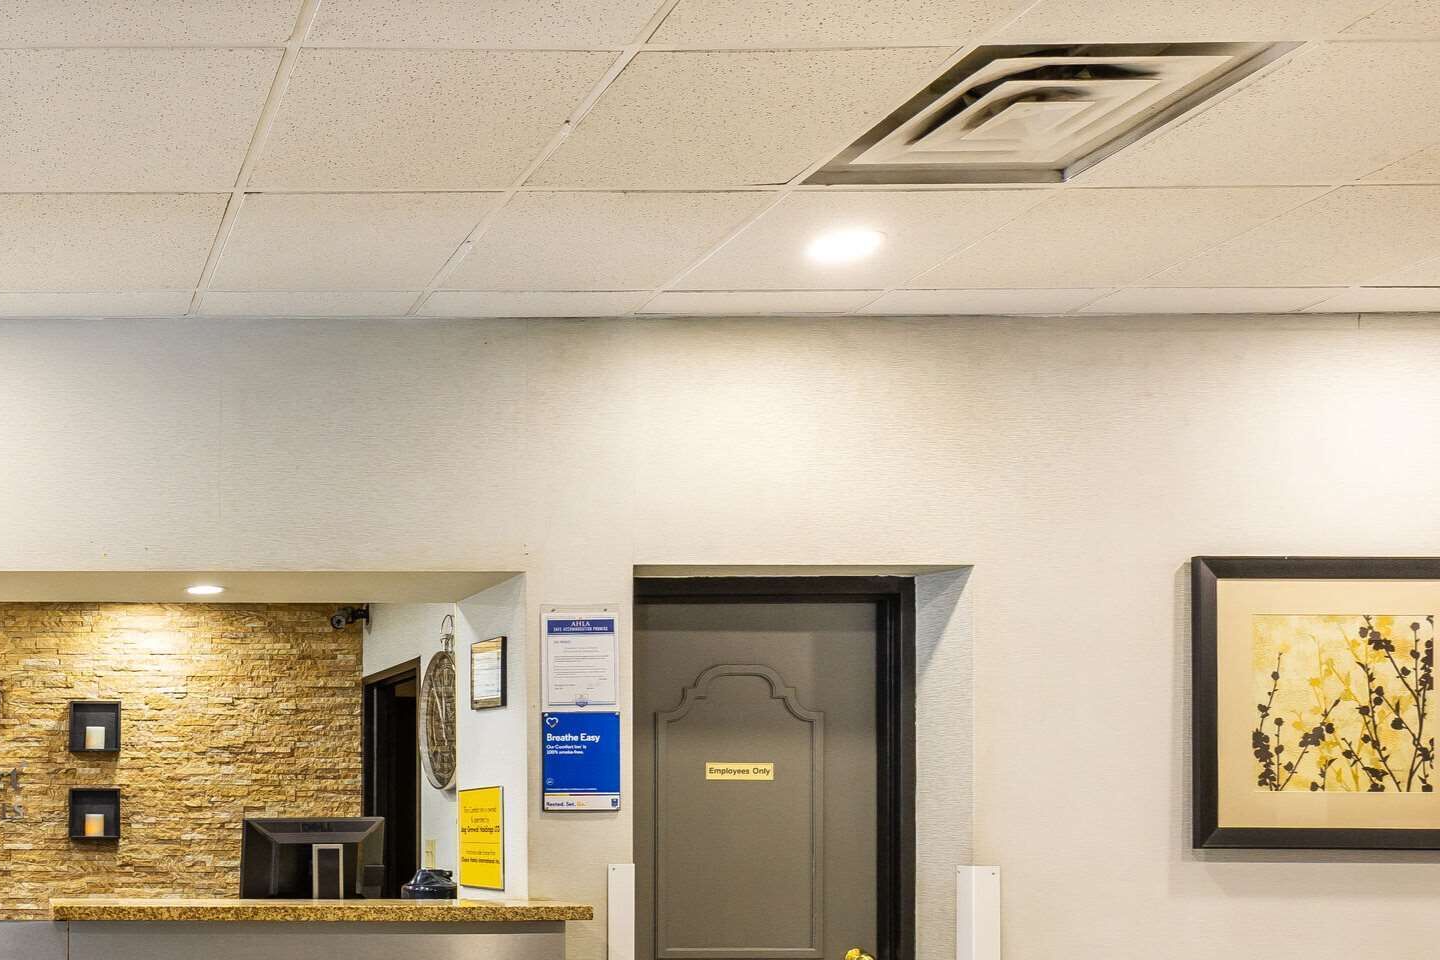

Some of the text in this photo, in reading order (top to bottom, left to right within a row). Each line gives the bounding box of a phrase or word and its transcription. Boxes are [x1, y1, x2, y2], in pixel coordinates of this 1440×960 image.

[546, 733, 601, 743] Breathe Easy
[708, 767, 770, 776] Employees Only
